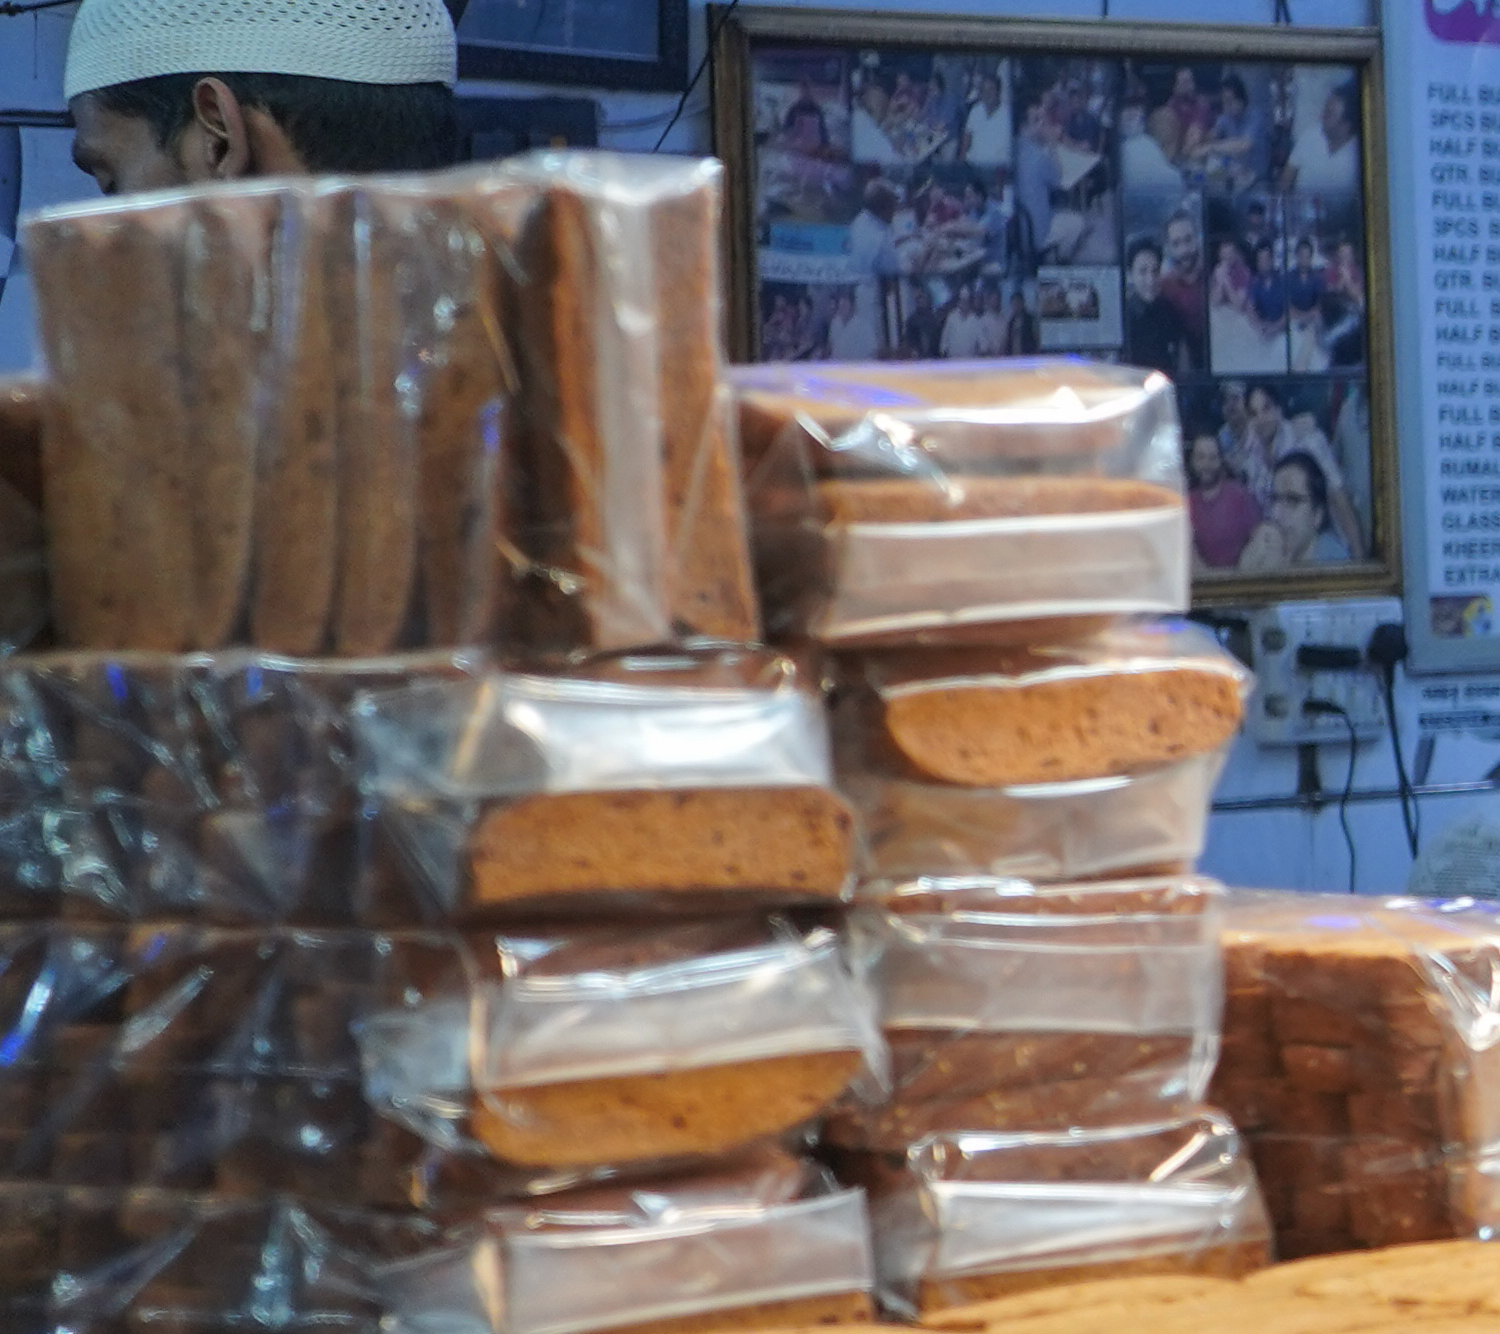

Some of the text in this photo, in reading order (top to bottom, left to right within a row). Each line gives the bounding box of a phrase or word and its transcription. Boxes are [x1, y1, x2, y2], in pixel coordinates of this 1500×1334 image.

[1428, 82, 1473, 104] FULL
[1429, 136, 1477, 158] HALF
[1432, 189, 1476, 212] FULL
[1433, 243, 1480, 264] HALF
[1435, 296, 1480, 318] FULL
[1436, 323, 1483, 345] HALF
[1438, 403, 1484, 425] FULL
[1439, 430, 1486, 452] HALF
